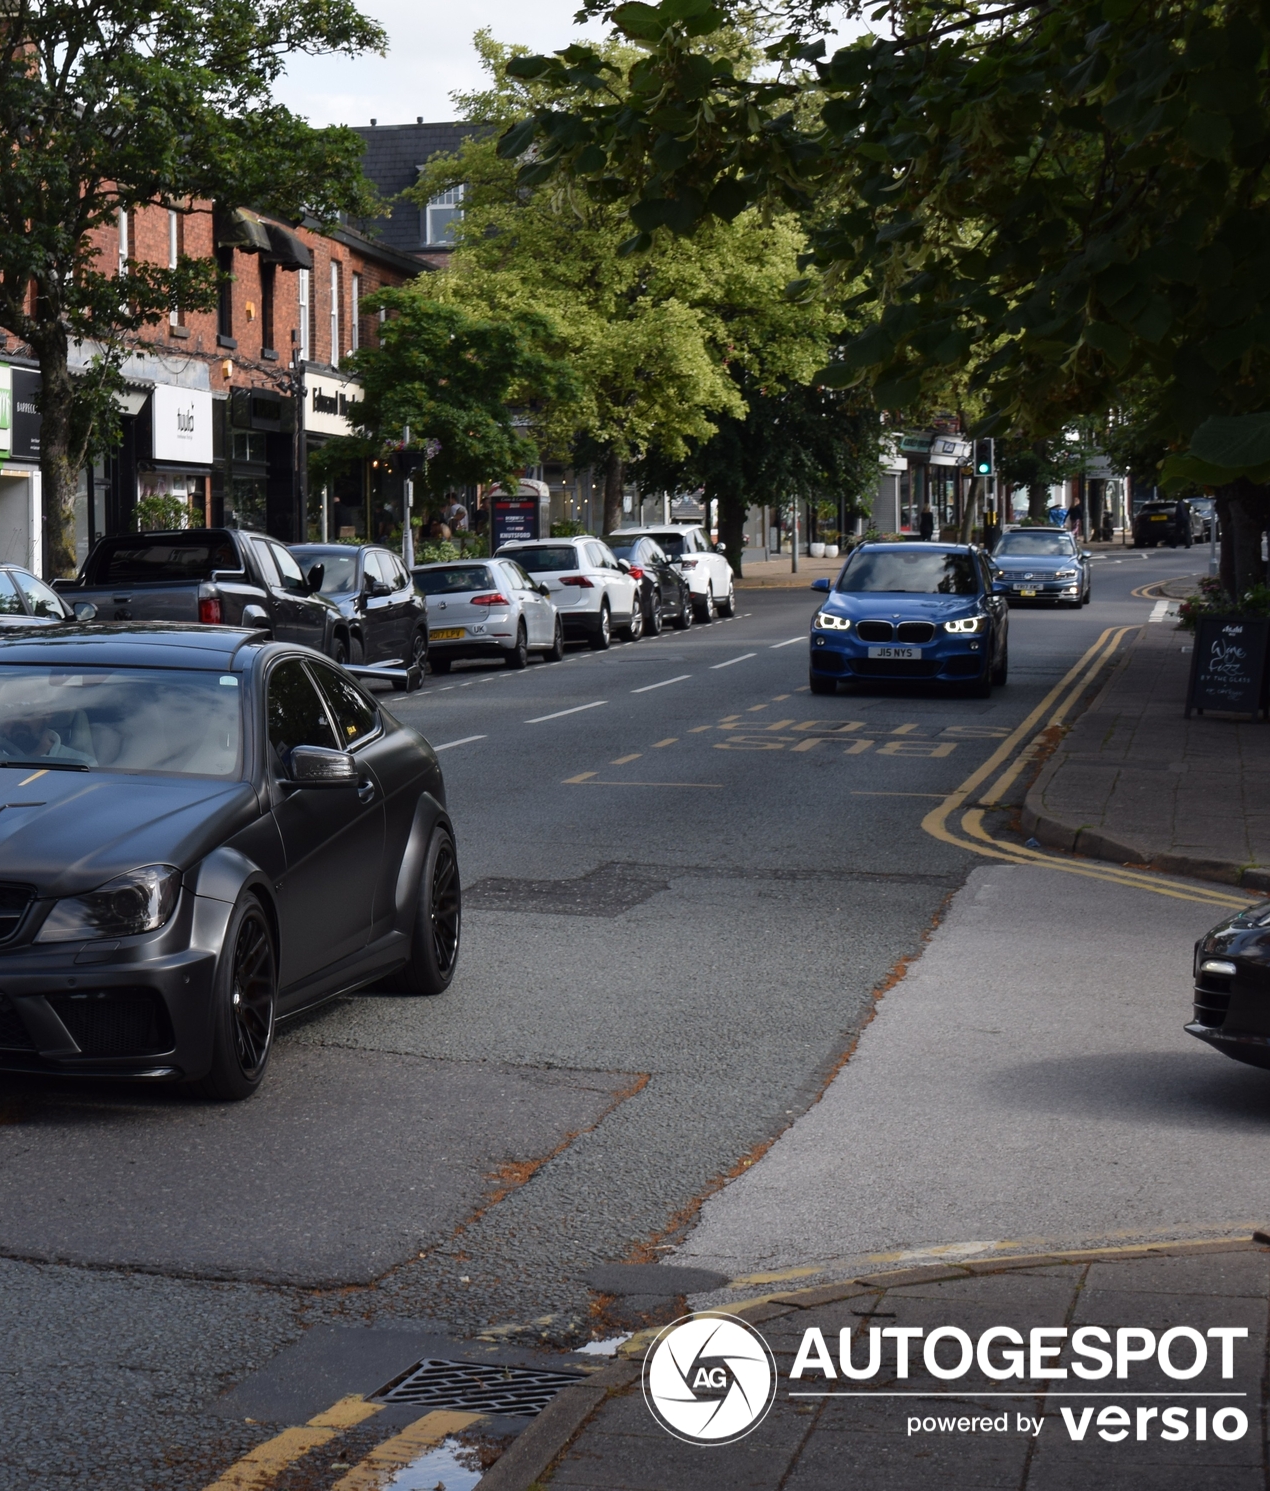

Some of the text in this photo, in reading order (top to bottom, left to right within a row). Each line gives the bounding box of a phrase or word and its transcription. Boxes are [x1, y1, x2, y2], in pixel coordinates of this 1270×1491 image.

[474, 625, 485, 633] UK
[894, 648, 912, 658] NYS
[1211, 638, 1246, 658] Wine
[712, 736, 958, 758] BUS
